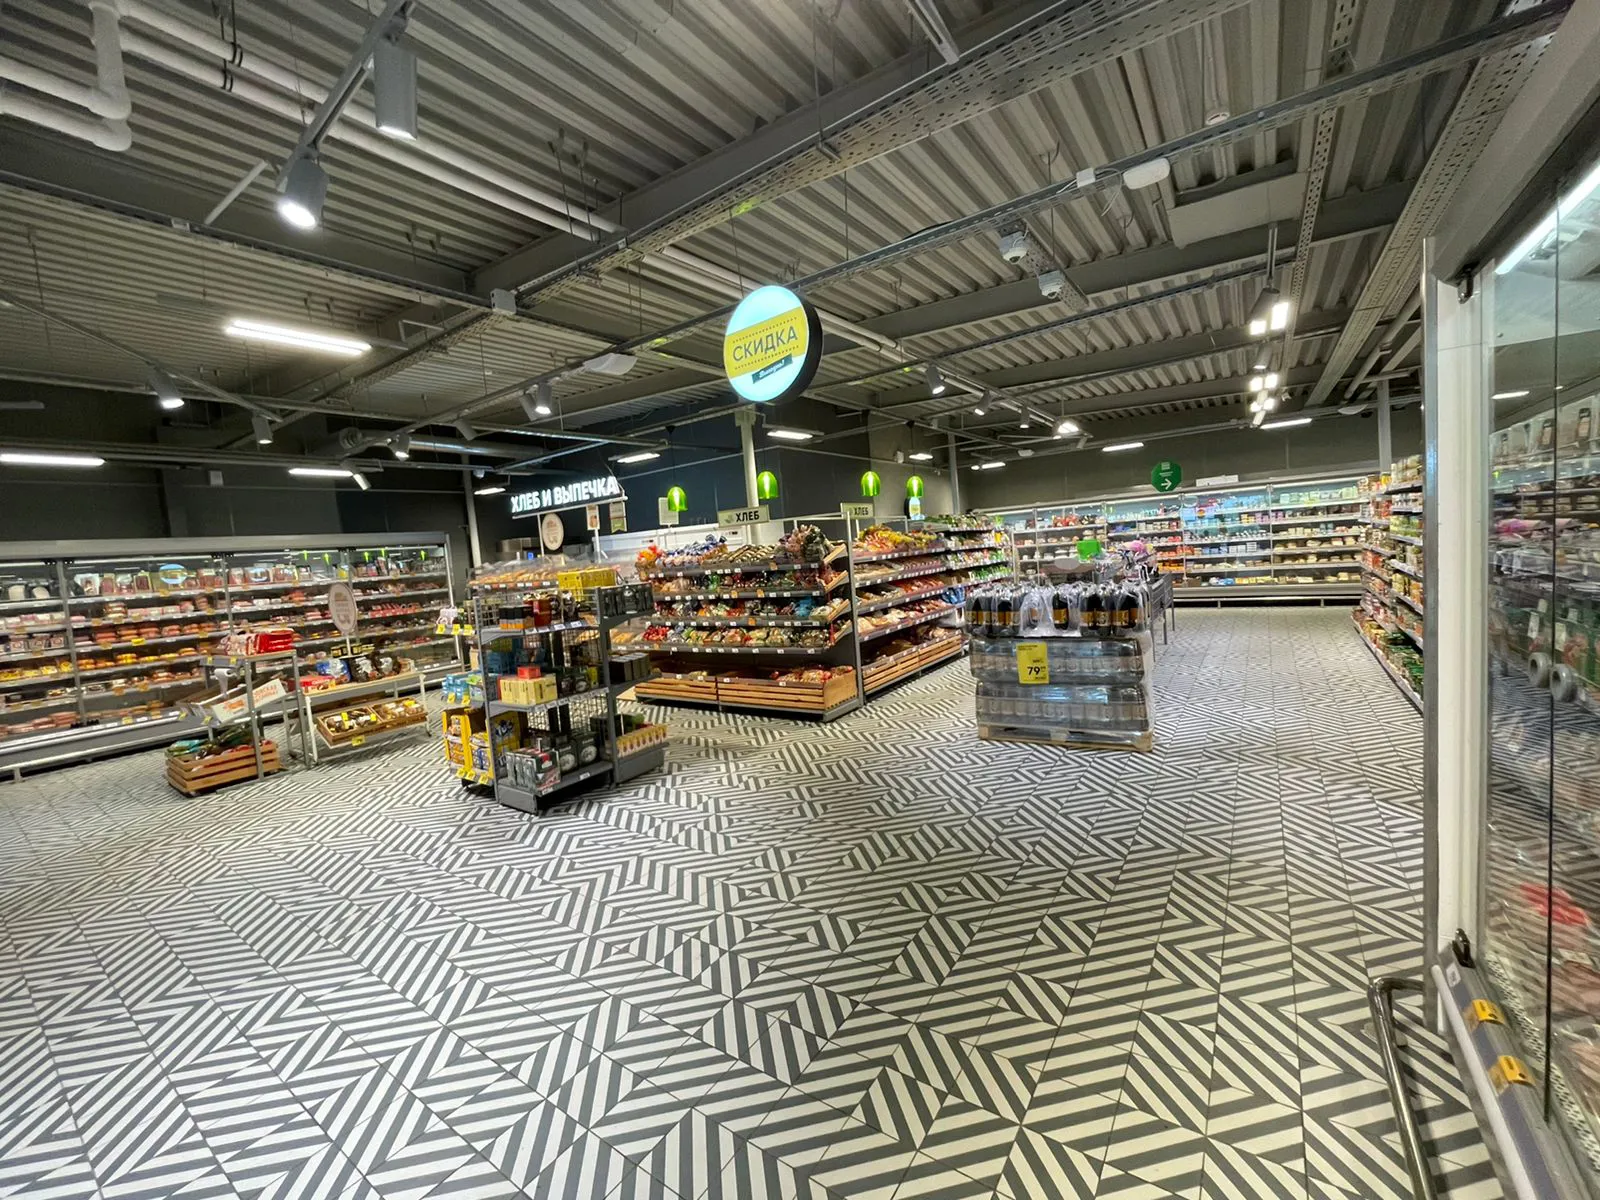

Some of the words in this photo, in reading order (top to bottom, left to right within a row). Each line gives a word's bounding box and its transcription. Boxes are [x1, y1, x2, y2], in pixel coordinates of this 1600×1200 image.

[733, 325, 798, 362] СКИДКА
[510, 490, 541, 513] ХЛЕБ
[541, 488, 553, 507] И
[553, 476, 621, 506] ВЫПЕЧКА
[735, 510, 760, 523] ХЛЕБ
[853, 506, 870, 516] ХЛЕБ
